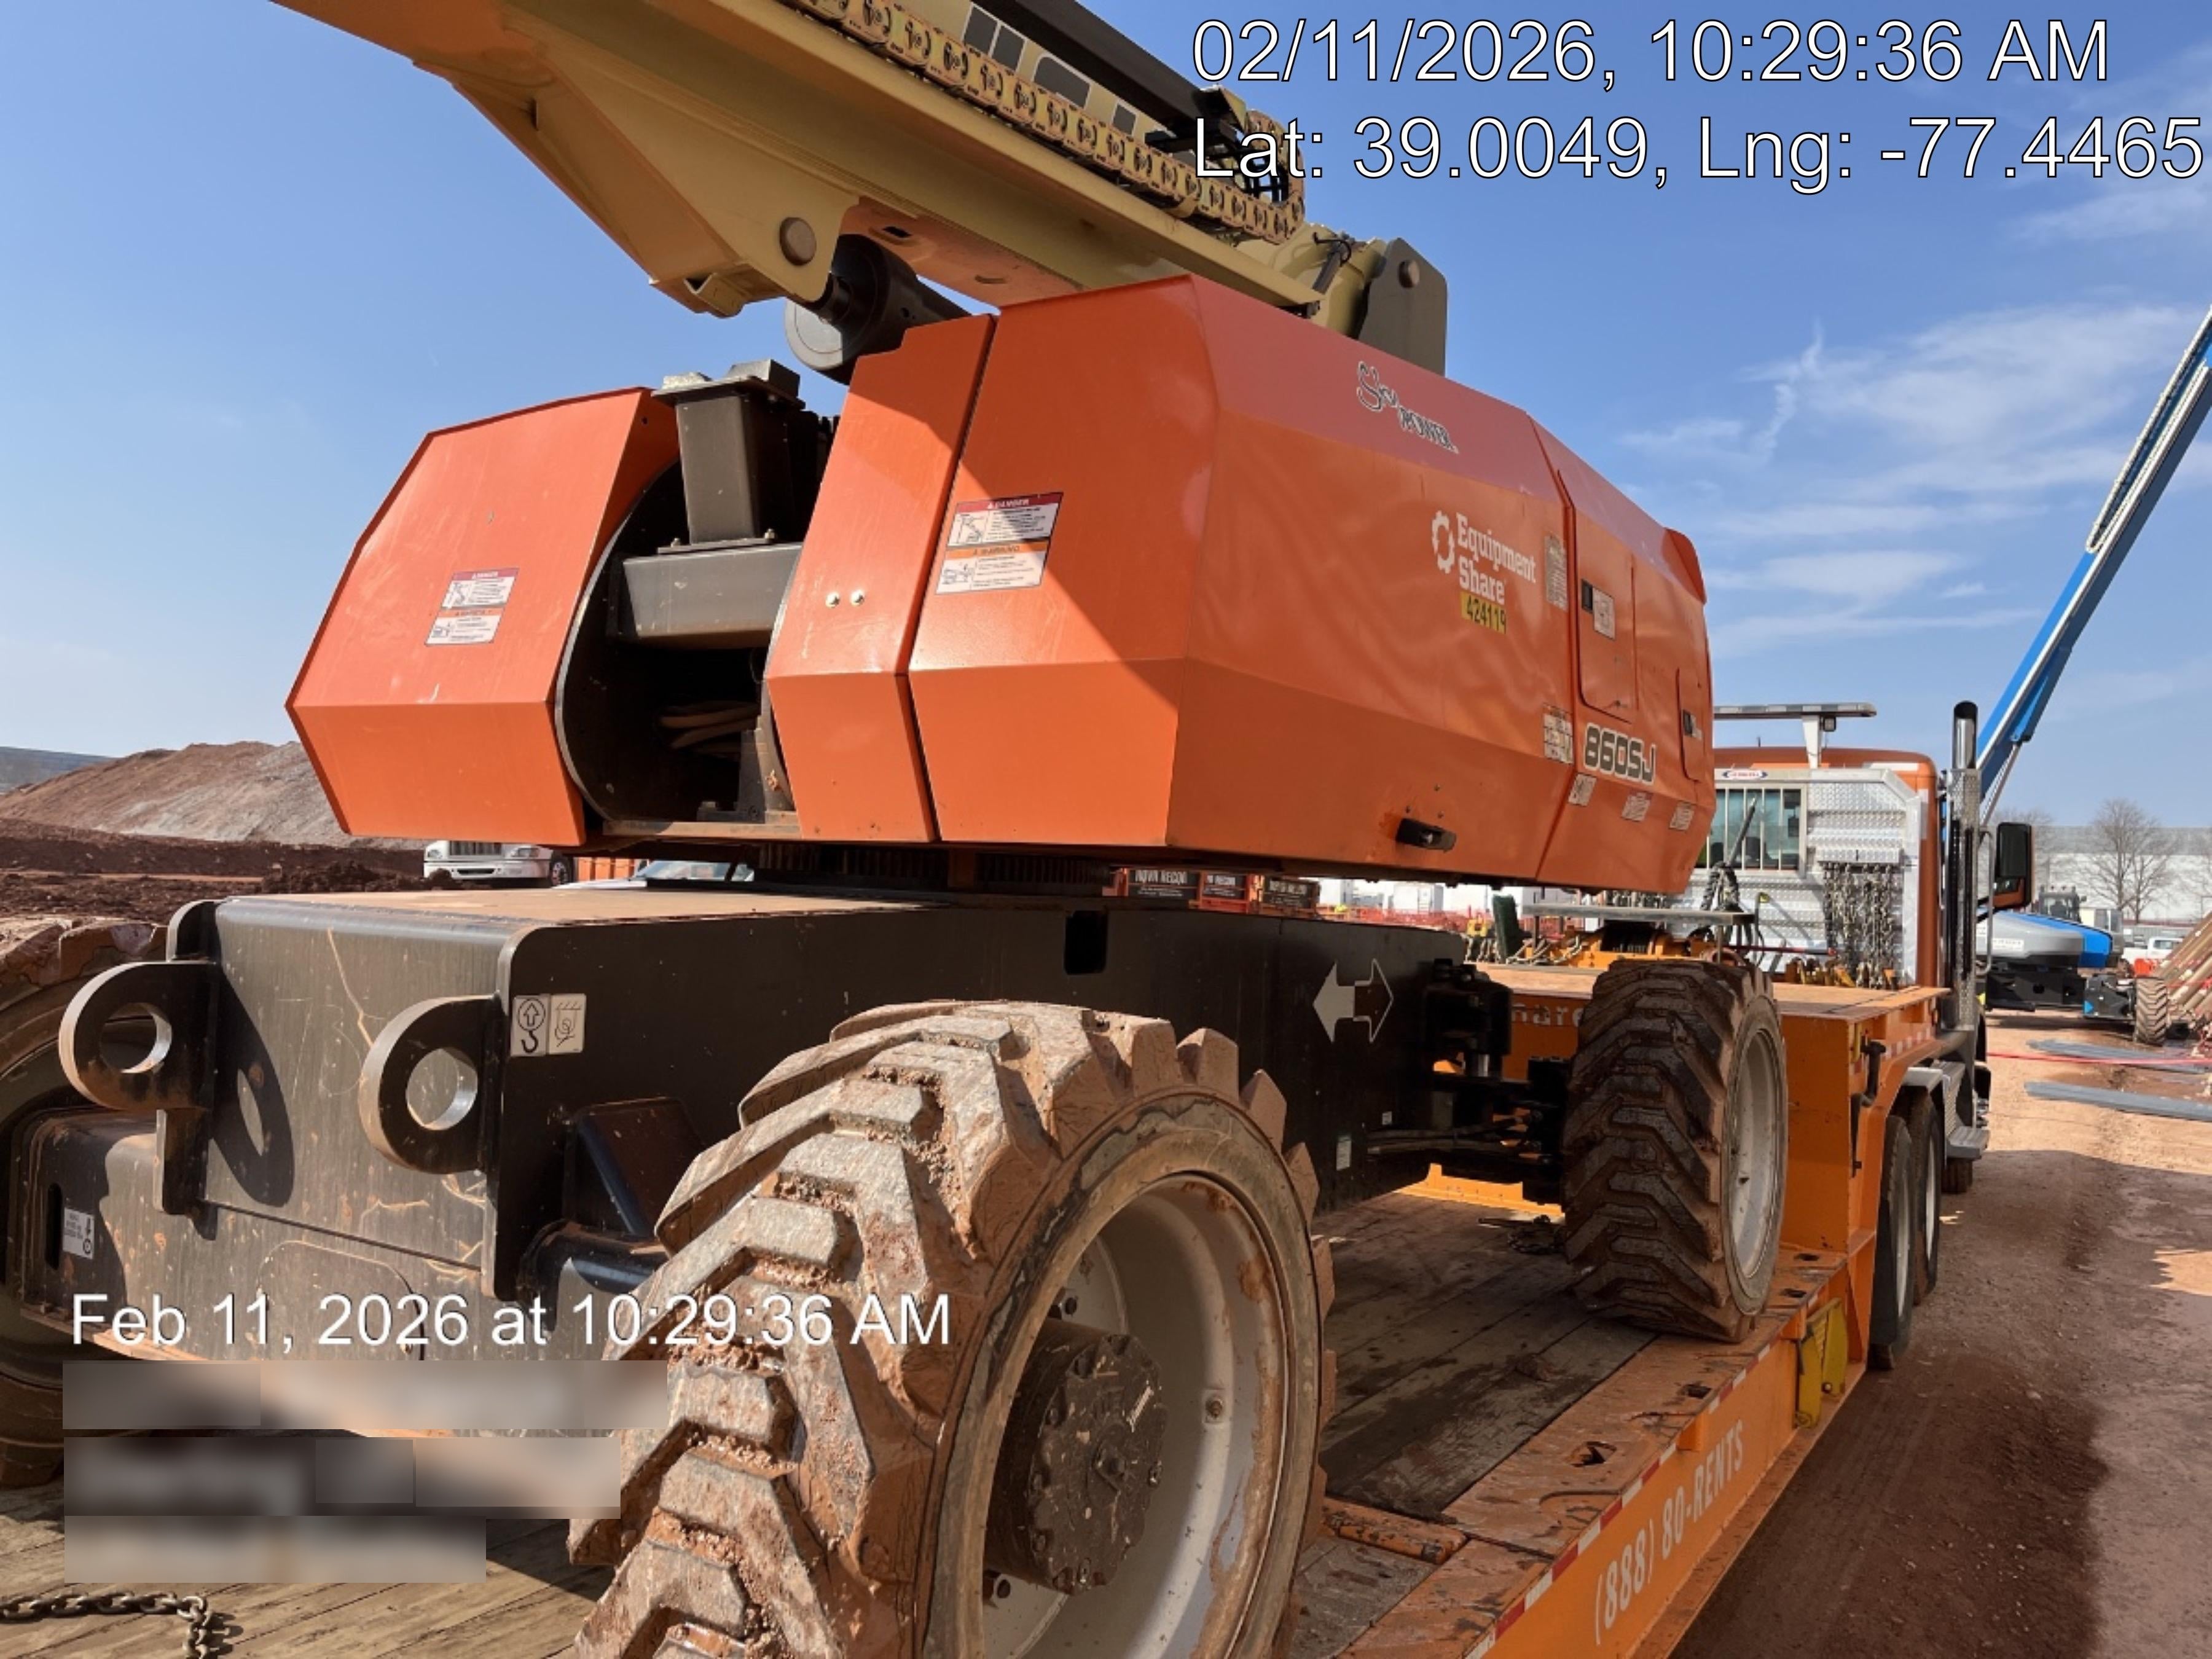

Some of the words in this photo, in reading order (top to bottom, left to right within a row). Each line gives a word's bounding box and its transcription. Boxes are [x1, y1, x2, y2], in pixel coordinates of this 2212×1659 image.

[1456, 511, 1536, 584] Equipment
[1459, 554, 1505, 606] Share
[1466, 595, 1506, 633] 424119
[1583, 723, 1657, 786] 860SJ
[1596, 1518, 1655, 1645] (888)
[1661, 1419, 1744, 1560] 80-RENTS
